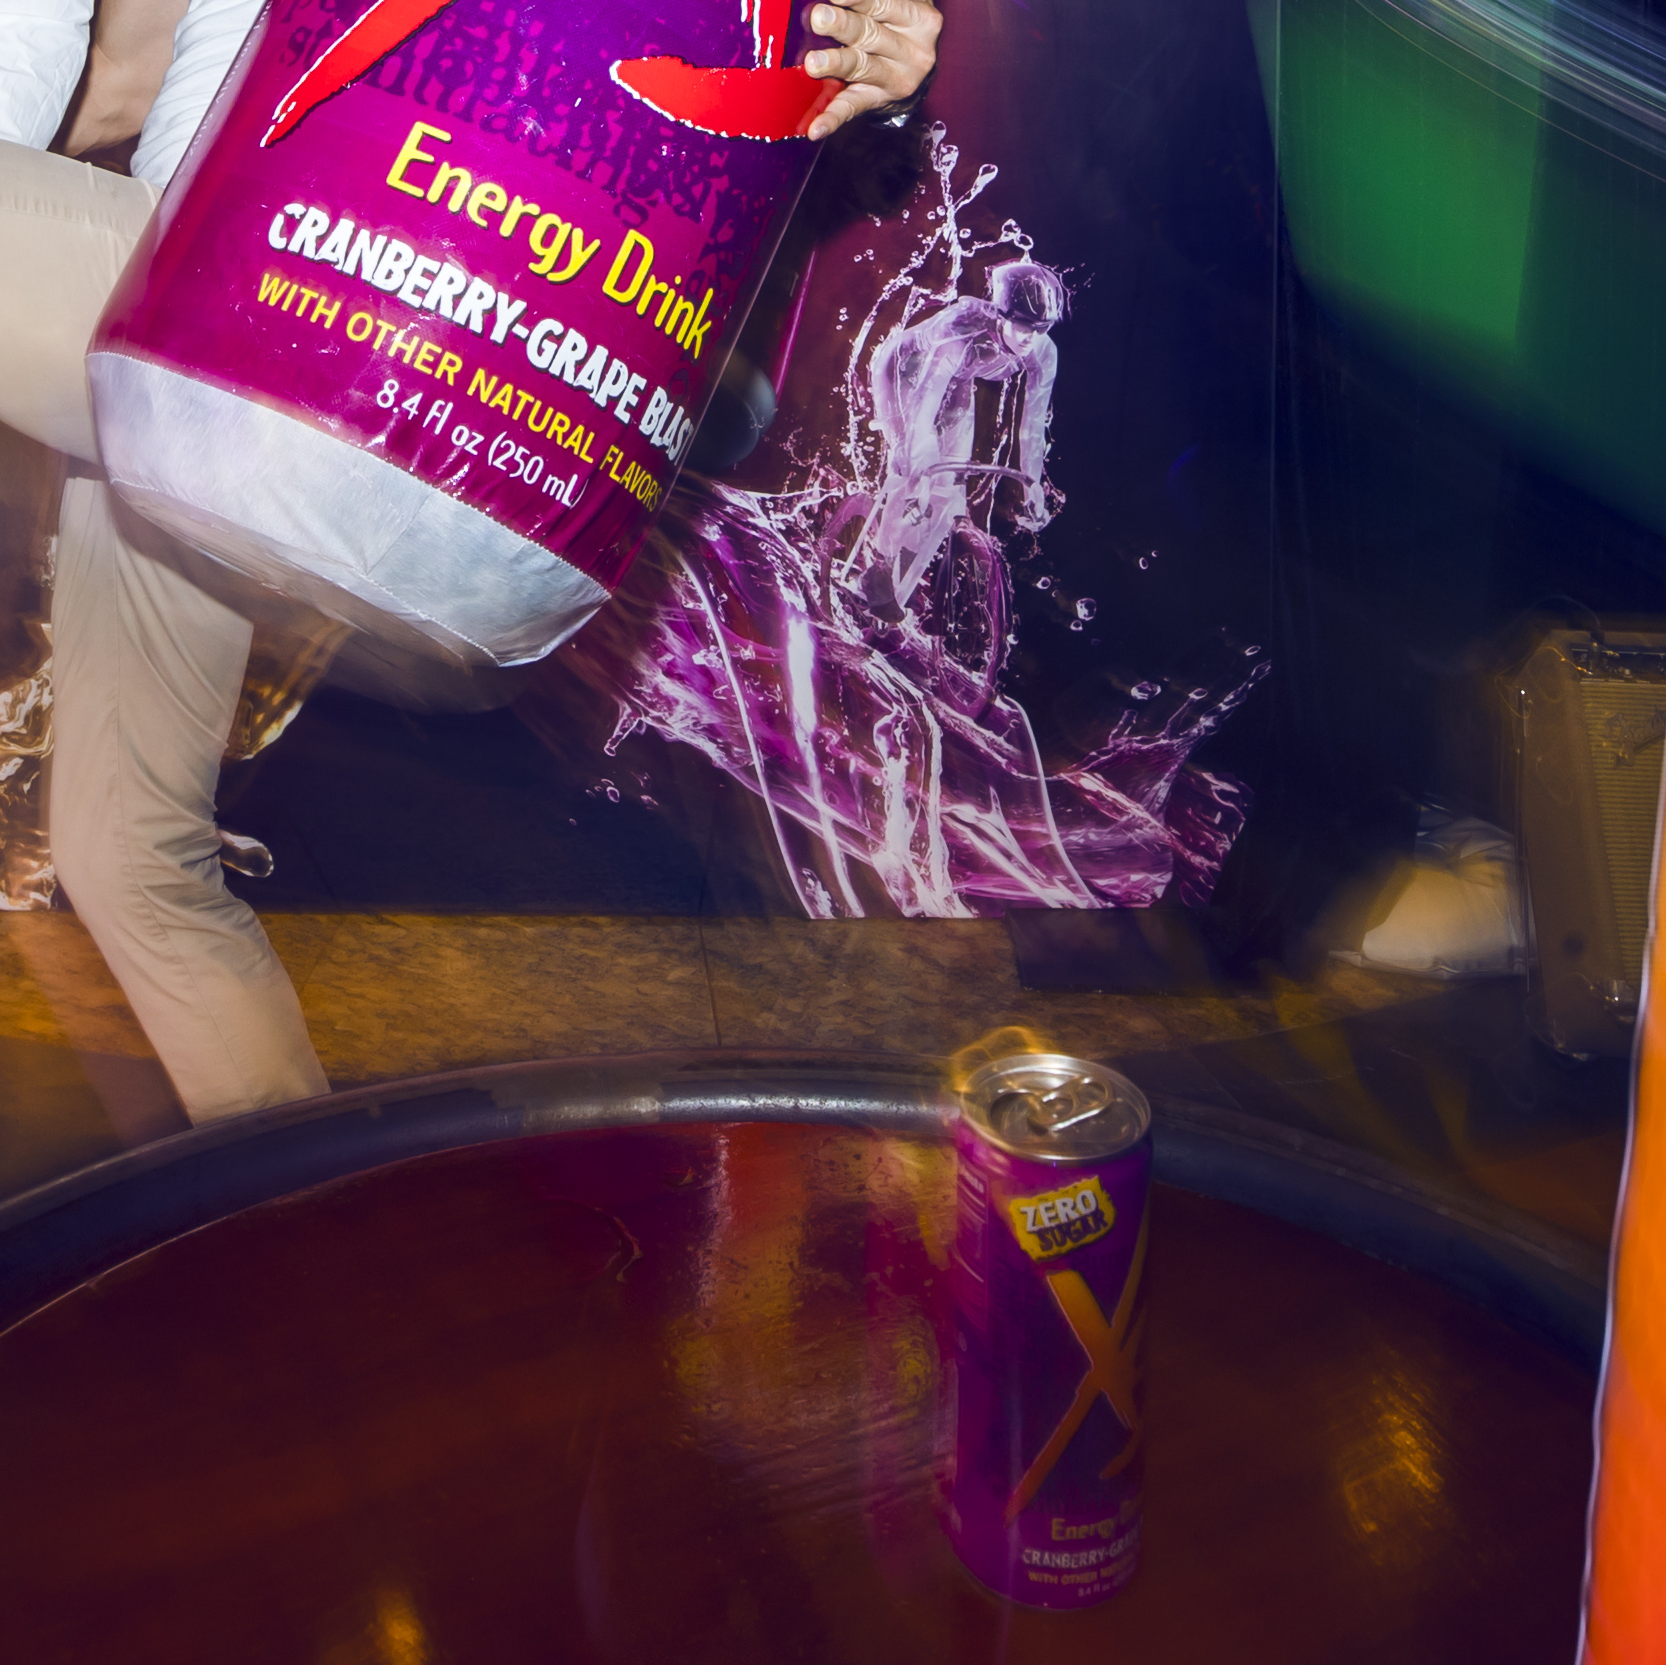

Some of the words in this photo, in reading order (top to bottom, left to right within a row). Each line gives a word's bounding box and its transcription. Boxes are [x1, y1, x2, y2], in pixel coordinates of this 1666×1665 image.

[267, 203, 646, 426] CRANBERRY-GRAPE
[386, 121, 601, 284] Energy
[602, 228, 713, 359] Drink
[257, 271, 342, 332] WITH
[345, 310, 464, 385] OTHER
[467, 366, 596, 465] NATURAL
[599, 443, 663, 513] FLAVORS
[376, 378, 422, 421] 8.4
[423, 400, 452, 436] fl
[450, 421, 485, 457] oz
[486, 431, 543, 489] (250
[1020, 1189, 1099, 1233] ZERO
[1035, 1209, 1108, 1252] SUGAR
